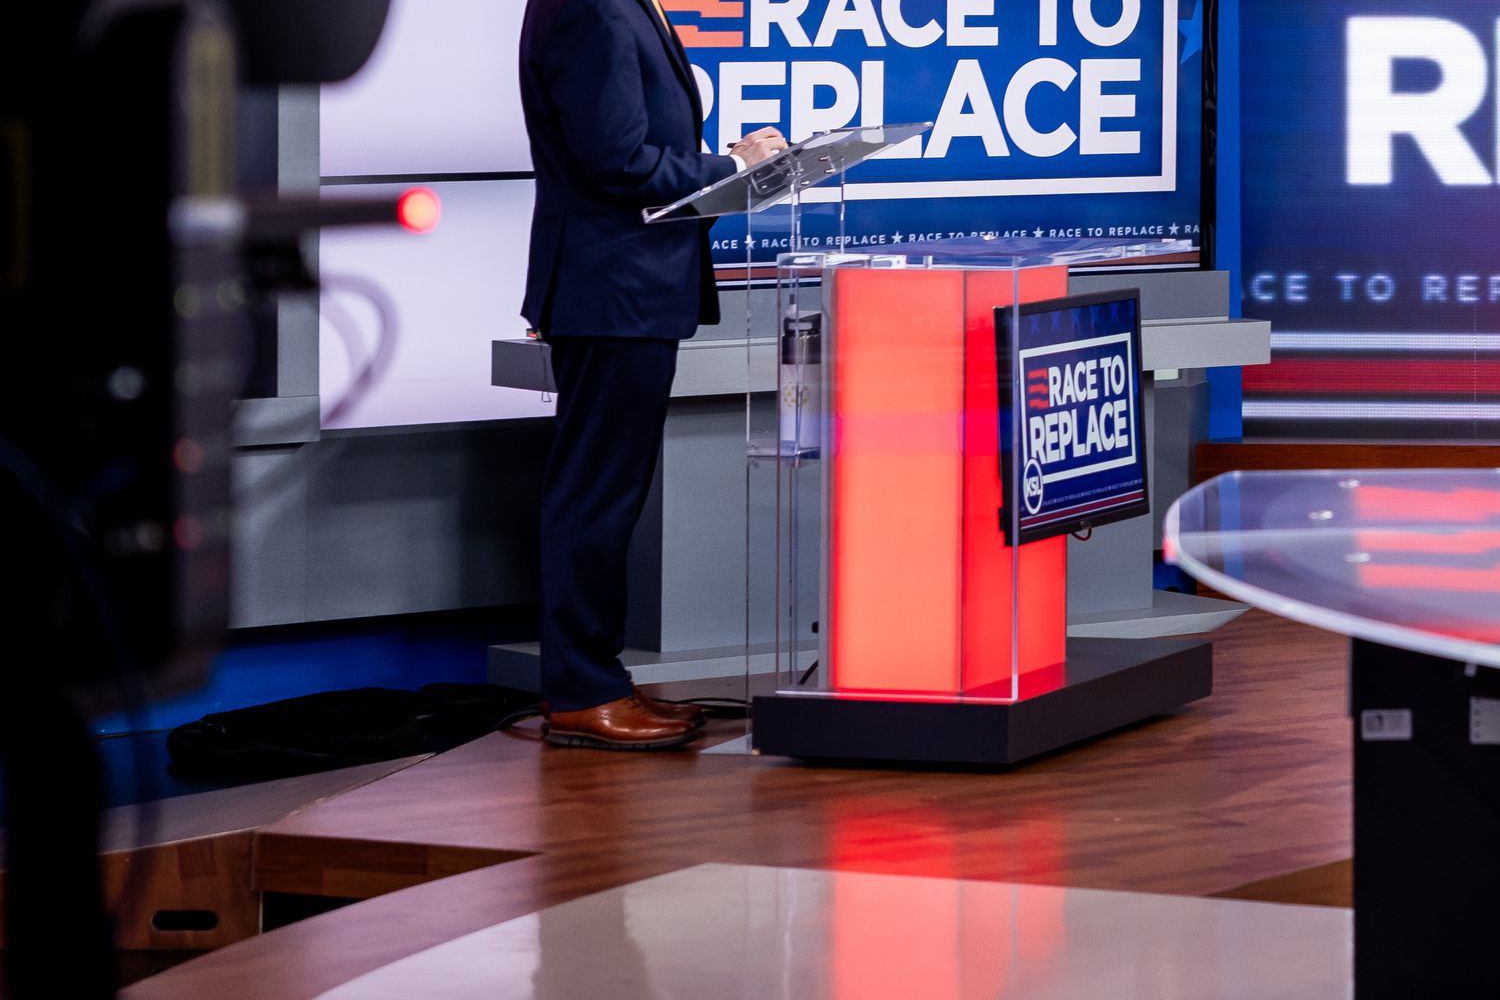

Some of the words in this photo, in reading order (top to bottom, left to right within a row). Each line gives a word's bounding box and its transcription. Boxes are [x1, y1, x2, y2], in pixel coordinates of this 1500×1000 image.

[804, 236, 820, 247] TO
[826, 233, 886, 247] REPLACE
[1050, 228, 1082, 238] RACE
[1088, 227, 1103, 237] TO
[1109, 225, 1164, 237] REPLACE
[1336, 274, 1395, 301] TO
[1048, 359, 1099, 408] RACE
[1100, 354, 1125, 397] TO
[1029, 399, 1129, 465] REPLACE
[1025, 474, 1042, 499] KSL
